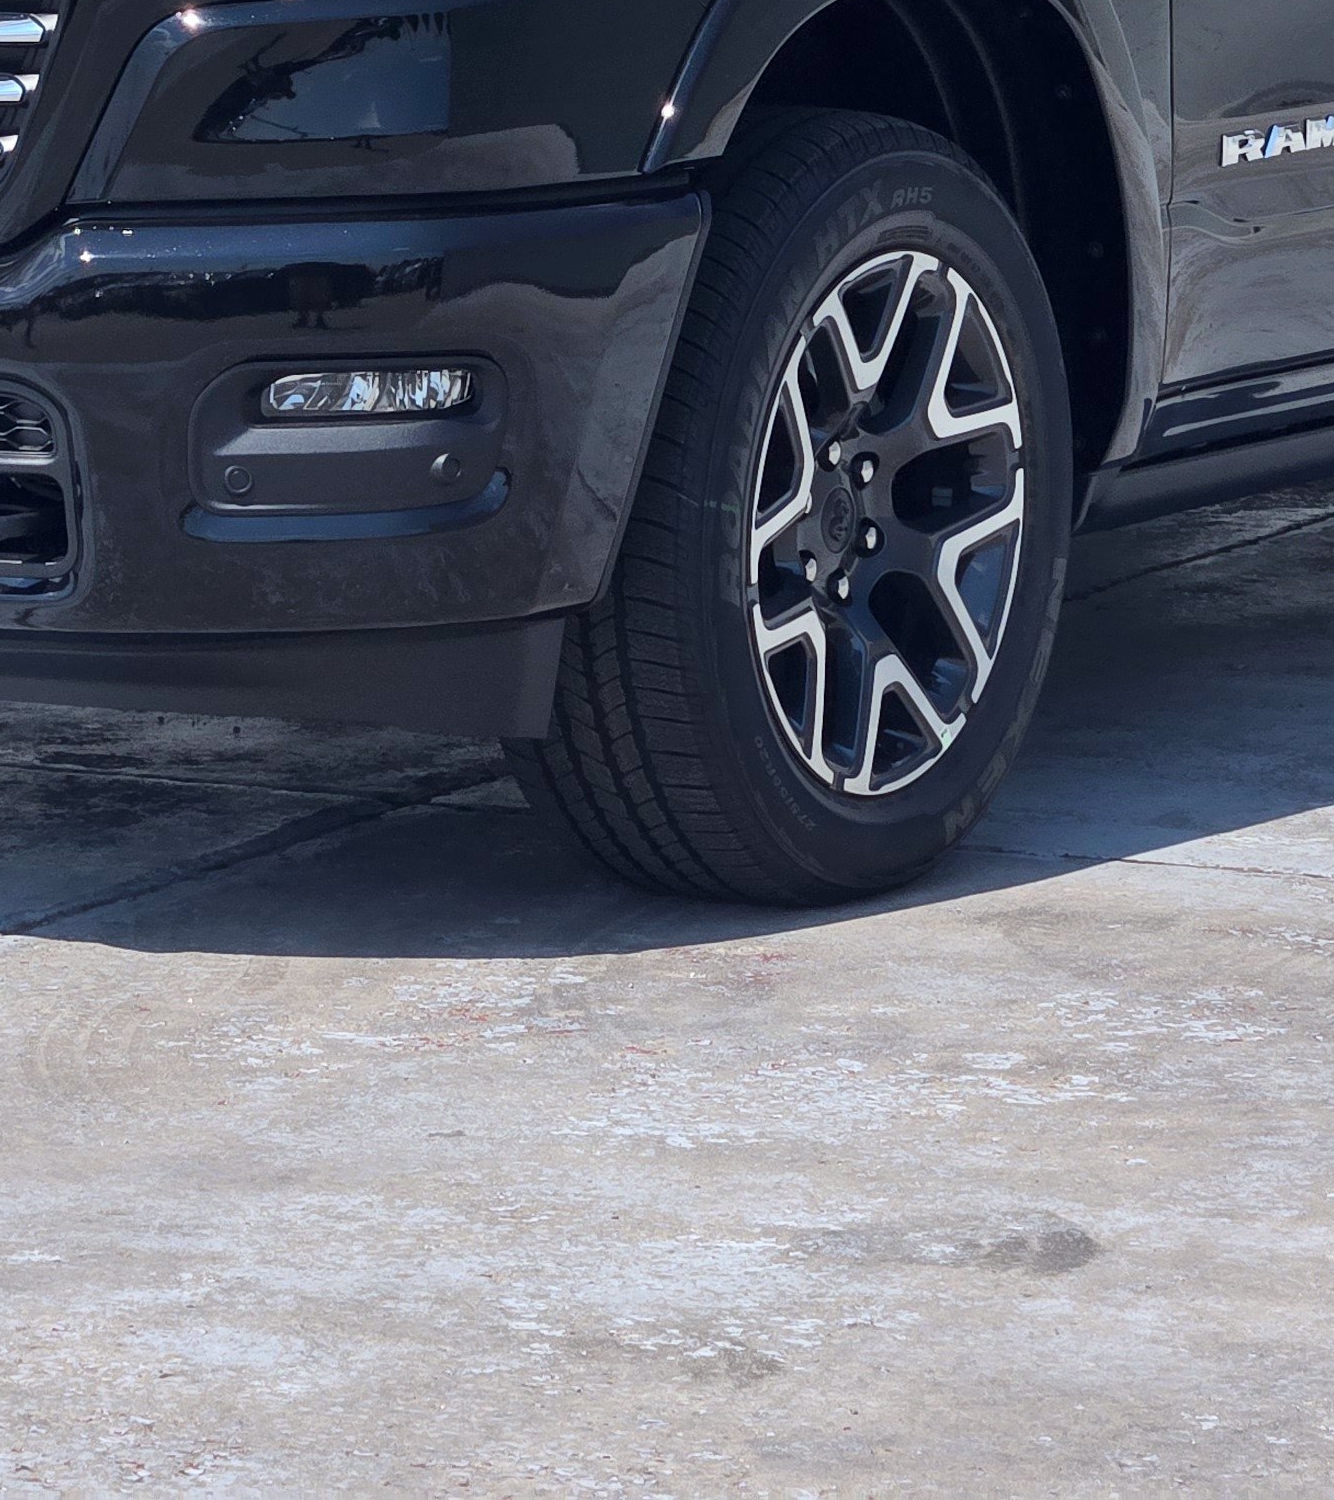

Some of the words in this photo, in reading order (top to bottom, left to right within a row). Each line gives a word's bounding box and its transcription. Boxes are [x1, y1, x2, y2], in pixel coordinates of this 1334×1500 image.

[813, 179, 886, 270] HTX
[890, 186, 934, 211] RH5
[943, 556, 1068, 845] NEXEN
